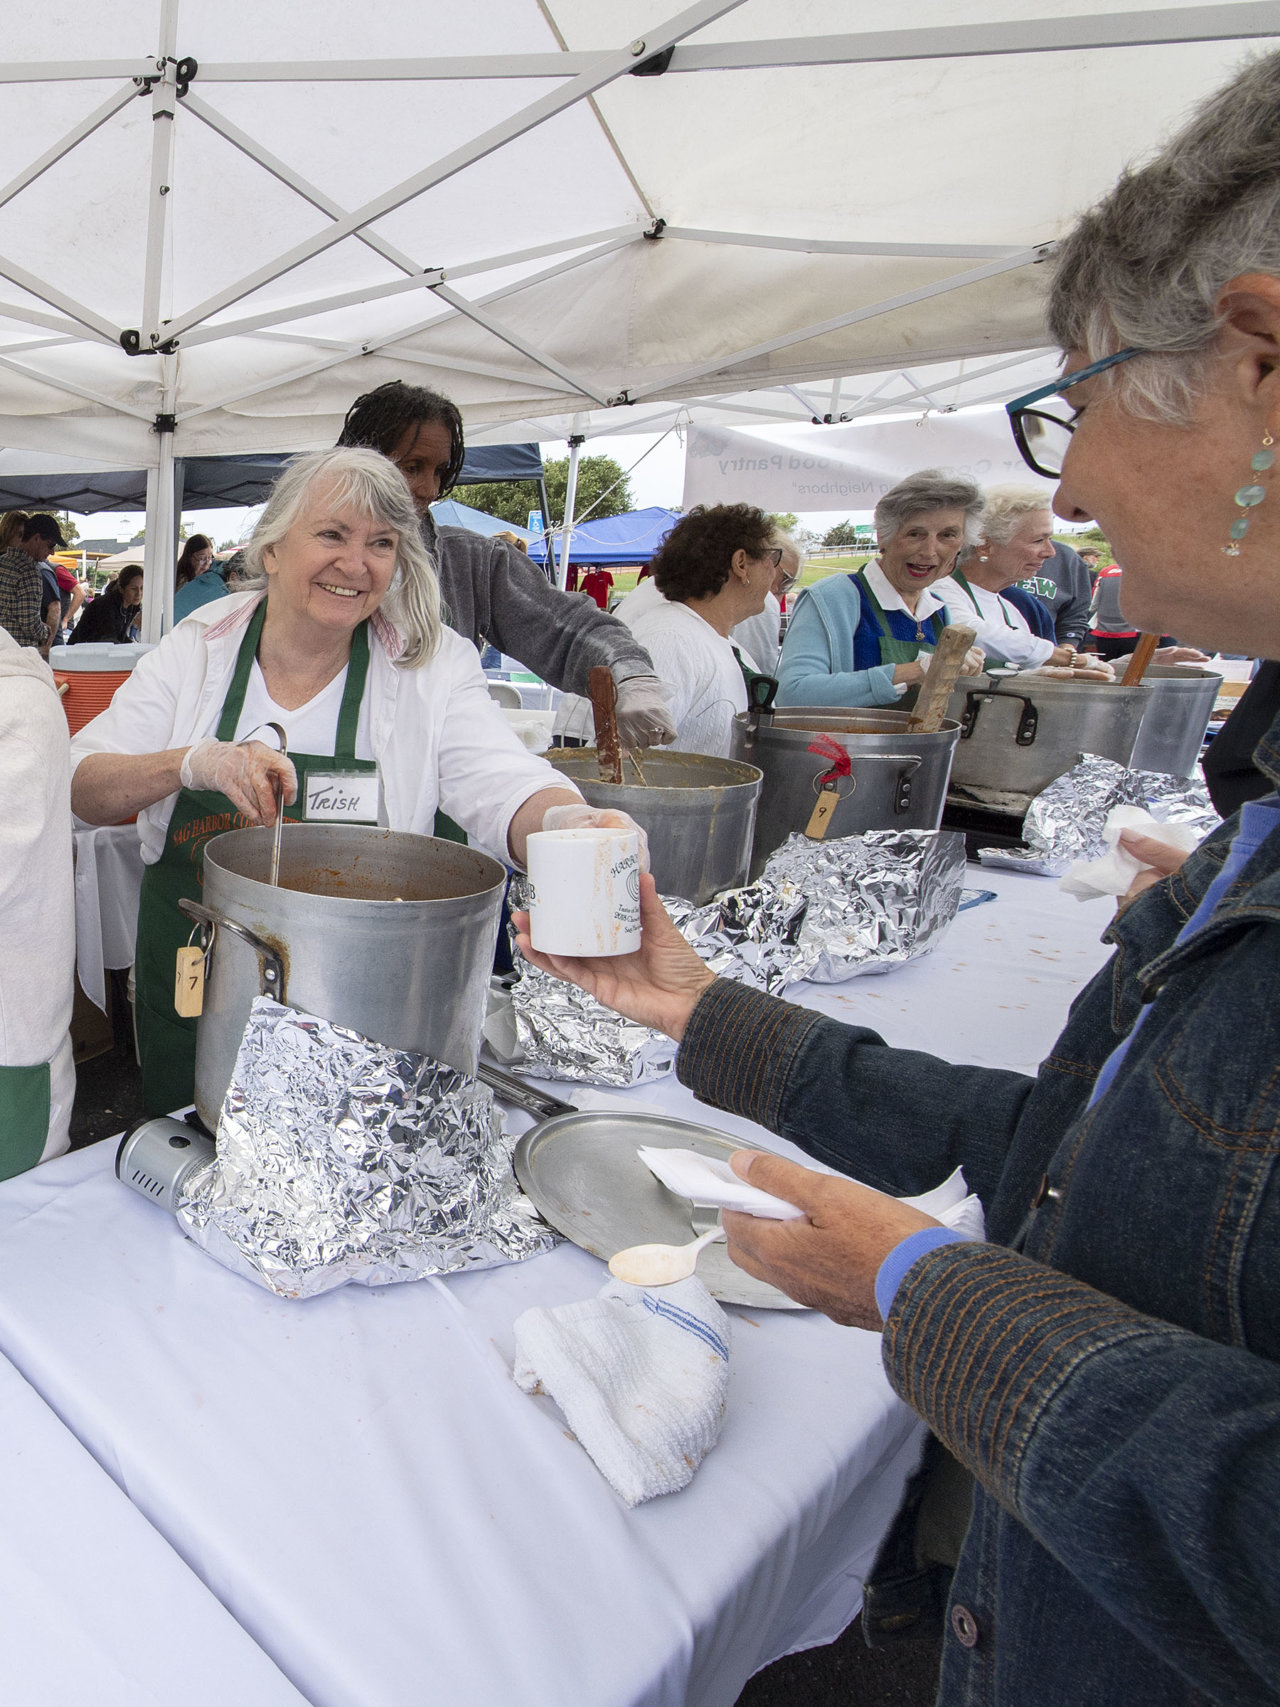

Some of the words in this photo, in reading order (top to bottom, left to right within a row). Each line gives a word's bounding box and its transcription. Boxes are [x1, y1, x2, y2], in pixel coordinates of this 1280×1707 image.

[1016, 576, 1058, 600] EW
[819, 807, 827, 818] 9
[173, 822, 191, 847] SAG
[191, 812, 231, 838] HARBOR
[189, 976, 199, 990] 7
